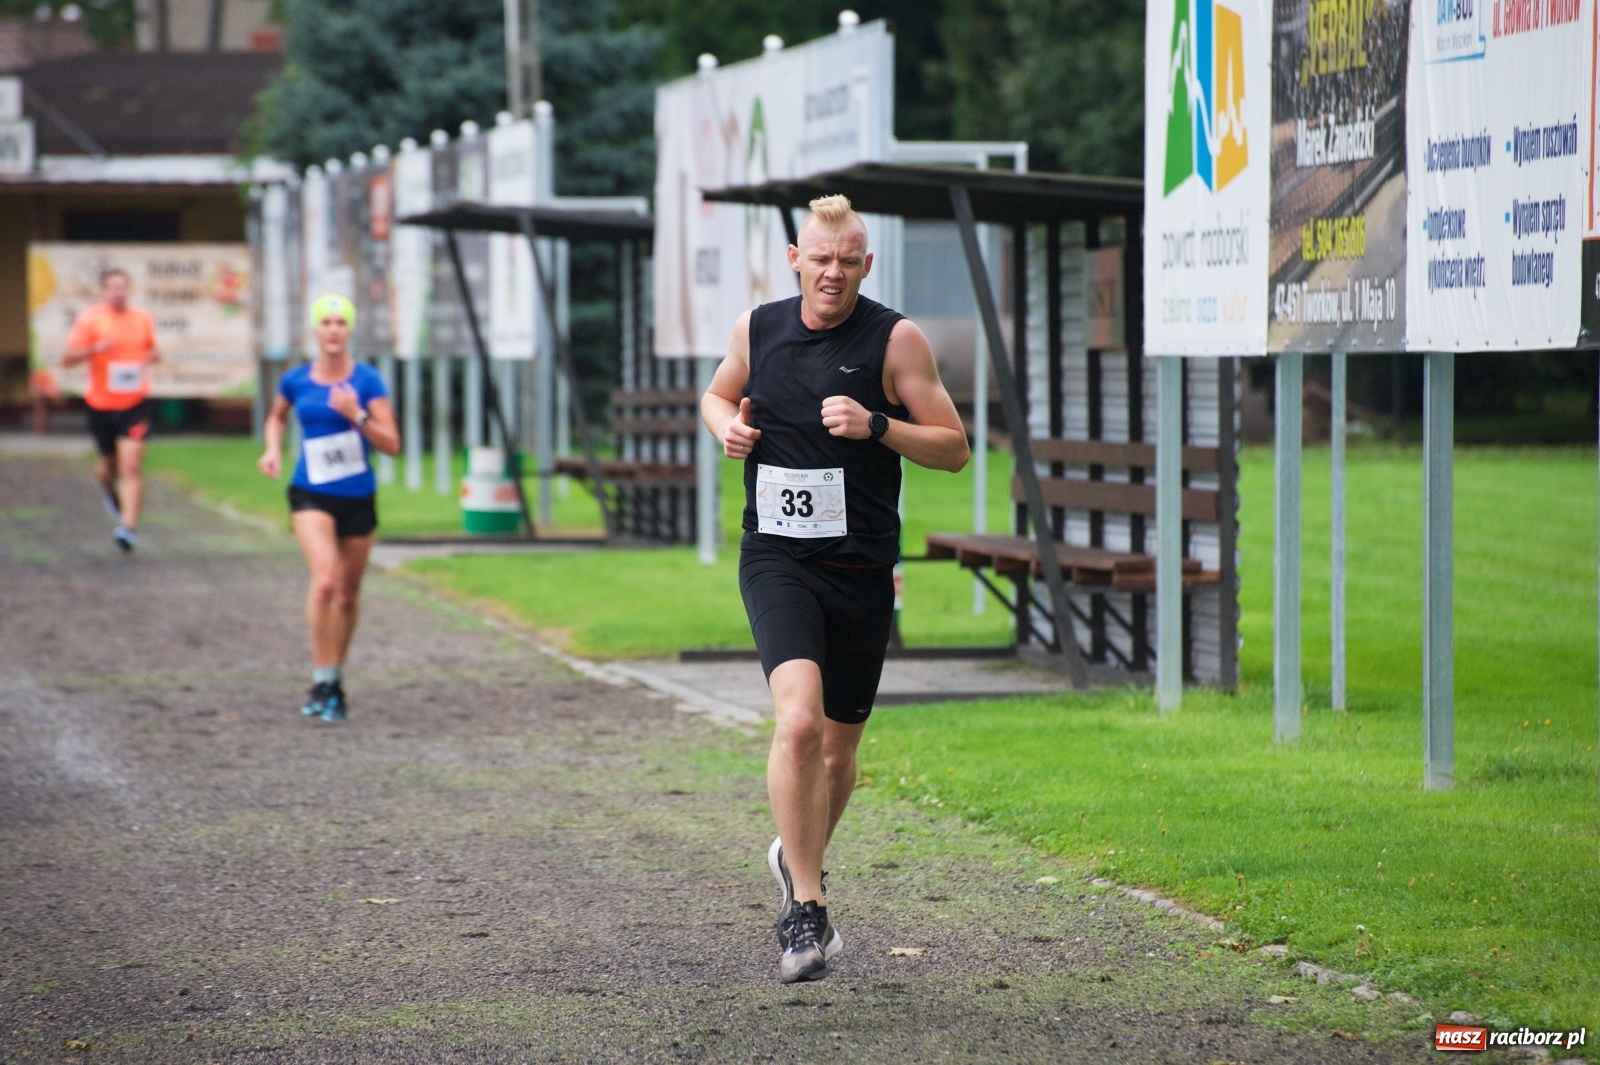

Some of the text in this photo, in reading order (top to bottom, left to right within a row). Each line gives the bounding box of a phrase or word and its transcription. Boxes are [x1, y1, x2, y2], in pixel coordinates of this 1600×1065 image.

[1297, 105, 1375, 168] Marek Zawadzki
[1461, 127, 1492, 172] budynków
[1513, 113, 1578, 167] Wynajem rusztowań
[1302, 217, 1316, 261] tel.
[1513, 193, 1566, 244] Wynajem sprzętu
[1512, 248, 1554, 288] budowlanego
[1341, 277, 1353, 322] ul.
[1354, 280, 1360, 321] 1
[1361, 277, 1383, 333] Maja
[1384, 277, 1396, 321] 10
[781, 489, 814, 518] 33
